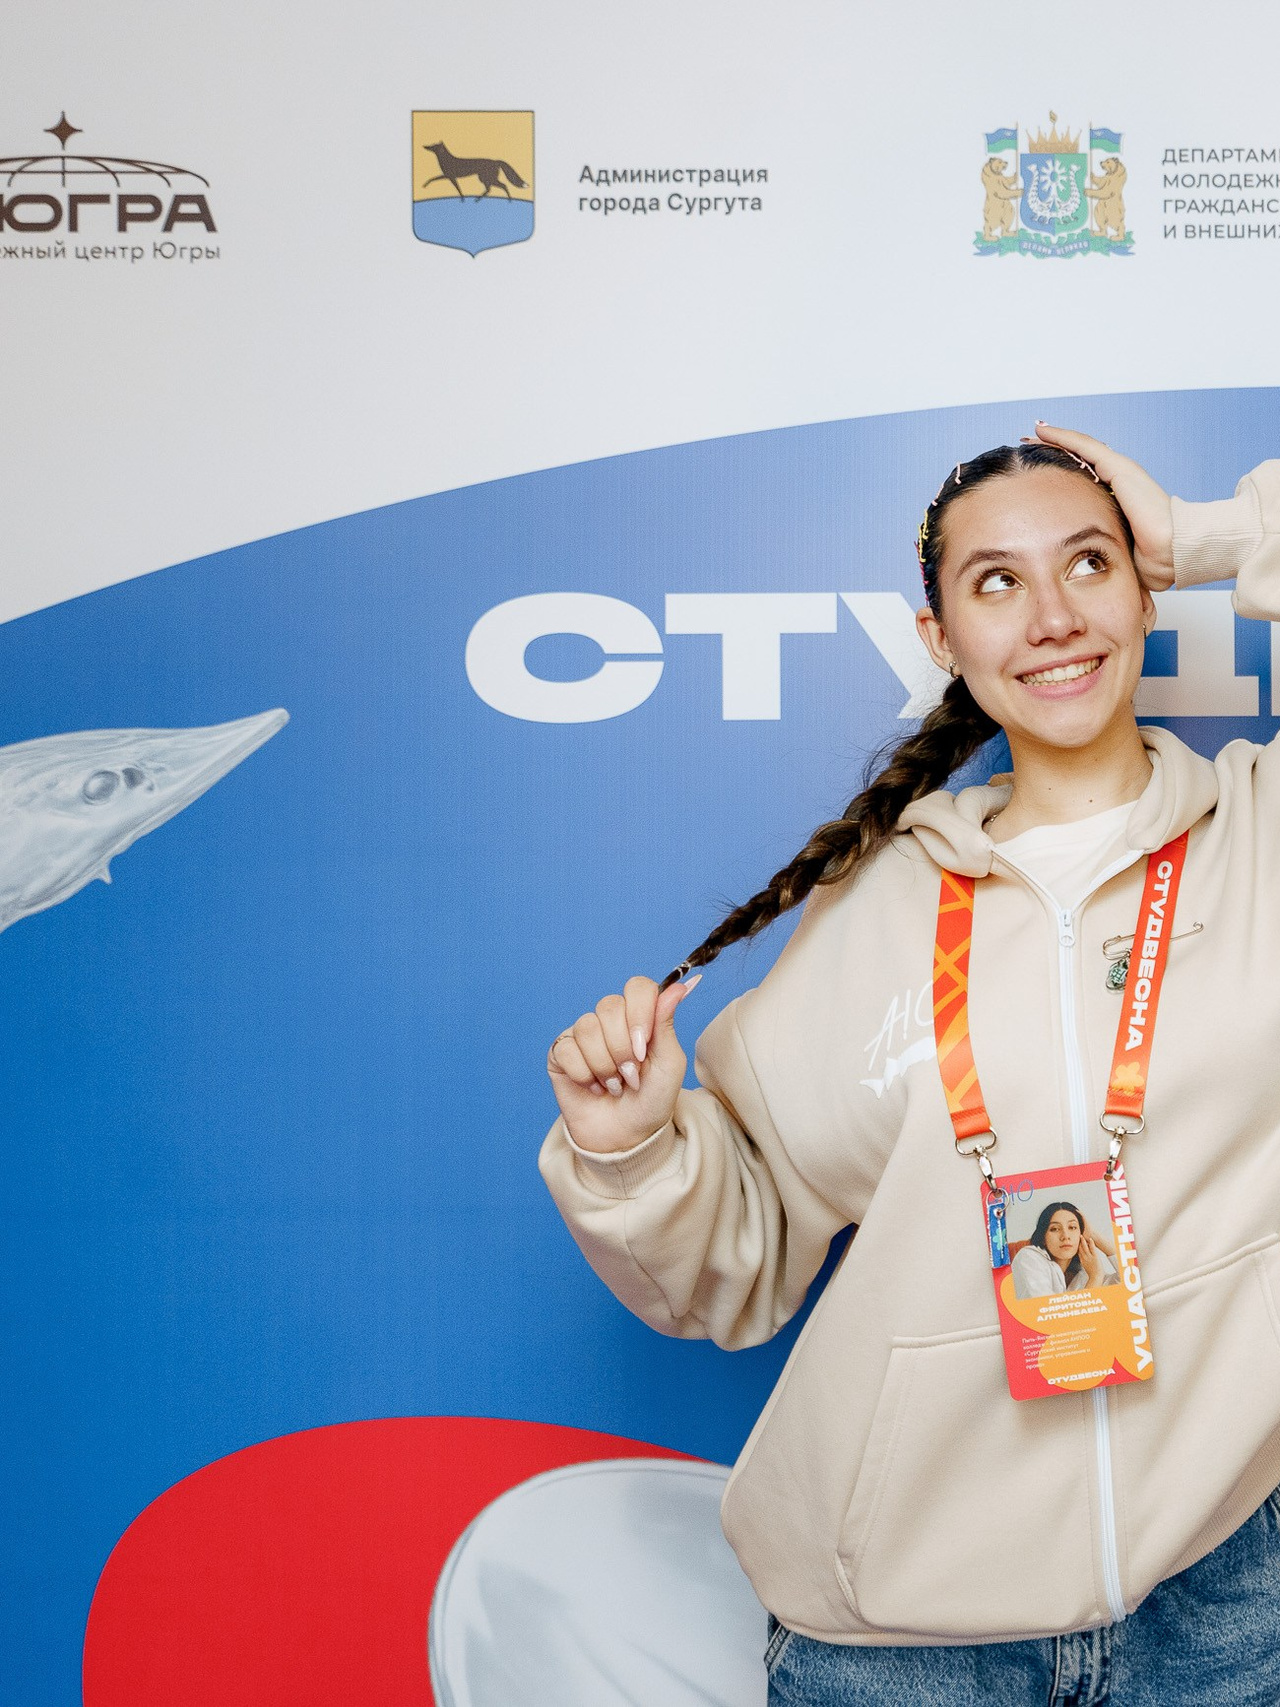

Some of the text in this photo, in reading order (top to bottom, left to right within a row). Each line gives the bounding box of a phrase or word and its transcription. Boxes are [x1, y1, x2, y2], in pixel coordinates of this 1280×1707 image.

[579, 165, 768, 186] Администрация
[0, 194, 218, 233] ЮГРА
[579, 193, 763, 215] города Сургута
[1163, 224, 1177, 238] И
[0, 240, 221, 264] жный центр Югры
[1125, 860, 1174, 1051] СТУДВЕСНА
[1109, 1163, 1154, 1372] УЧАСТНИК
